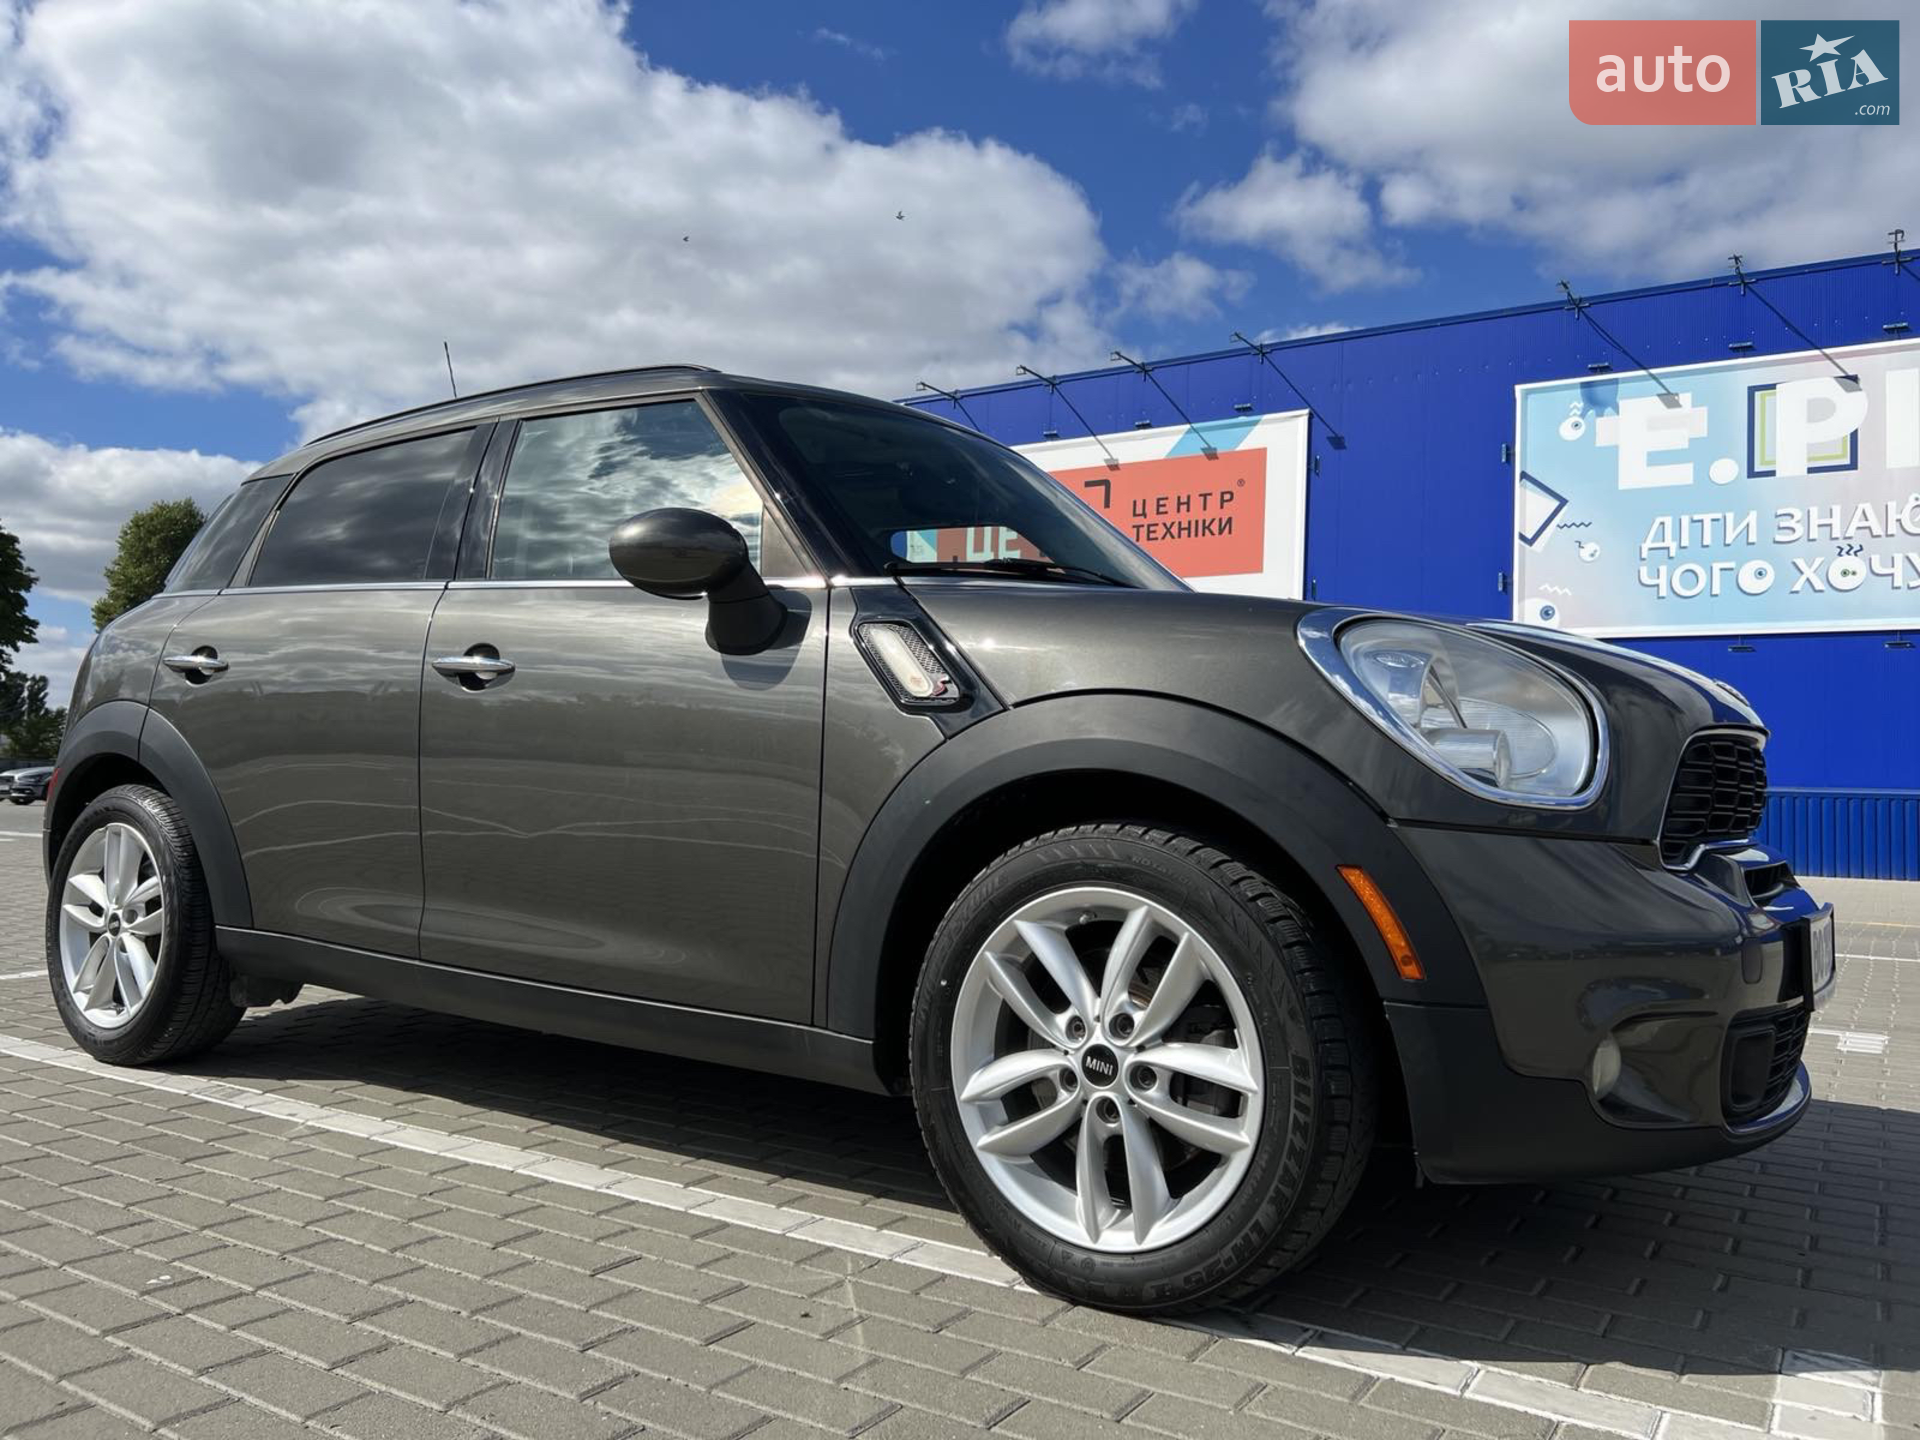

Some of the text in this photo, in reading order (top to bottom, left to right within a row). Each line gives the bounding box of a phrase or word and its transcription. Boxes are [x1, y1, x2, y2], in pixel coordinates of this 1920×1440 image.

[1132, 490, 1235, 519] ЦЕНТР
[1132, 516, 1233, 543] ТЕХНІКИ
[1640, 510, 1758, 560] ДІТИ
[1638, 559, 1776, 599] ЧОГО
[1086, 1056, 1114, 1076] MINI
